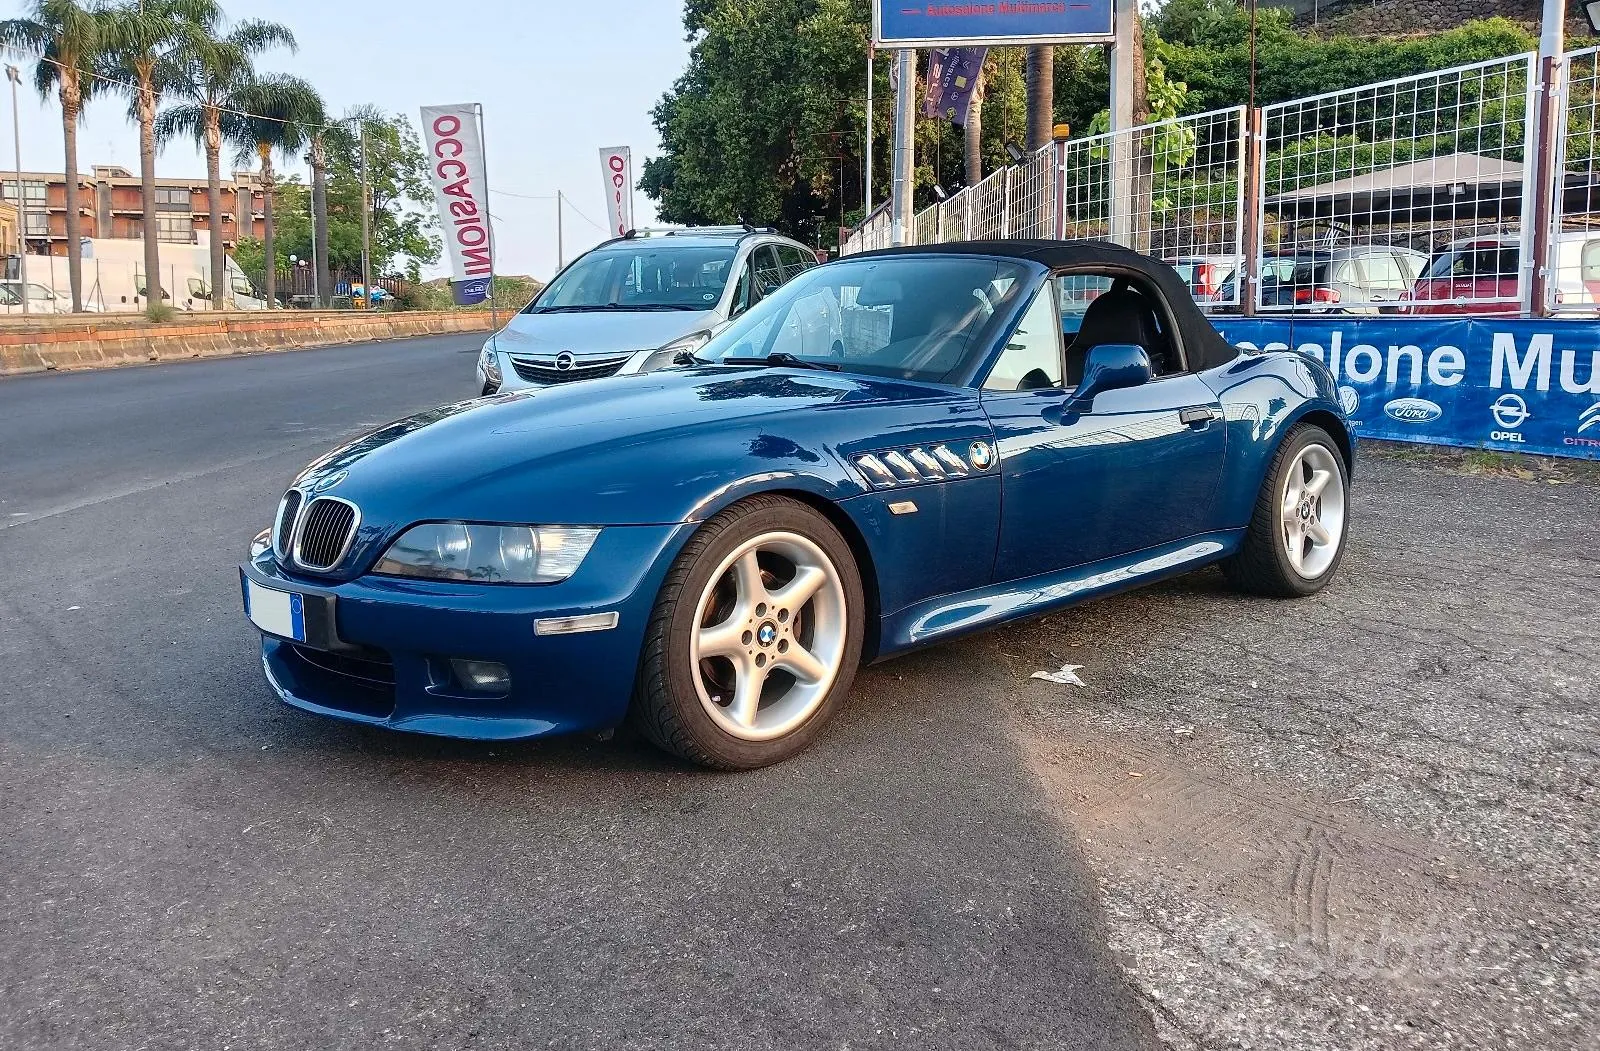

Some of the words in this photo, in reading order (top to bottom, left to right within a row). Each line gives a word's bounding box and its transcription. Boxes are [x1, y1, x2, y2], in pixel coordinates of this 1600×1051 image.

[1395, 403, 1429, 419] Ford
[1490, 431, 1526, 443] OPEL
[1563, 437, 1600, 447] CITR
